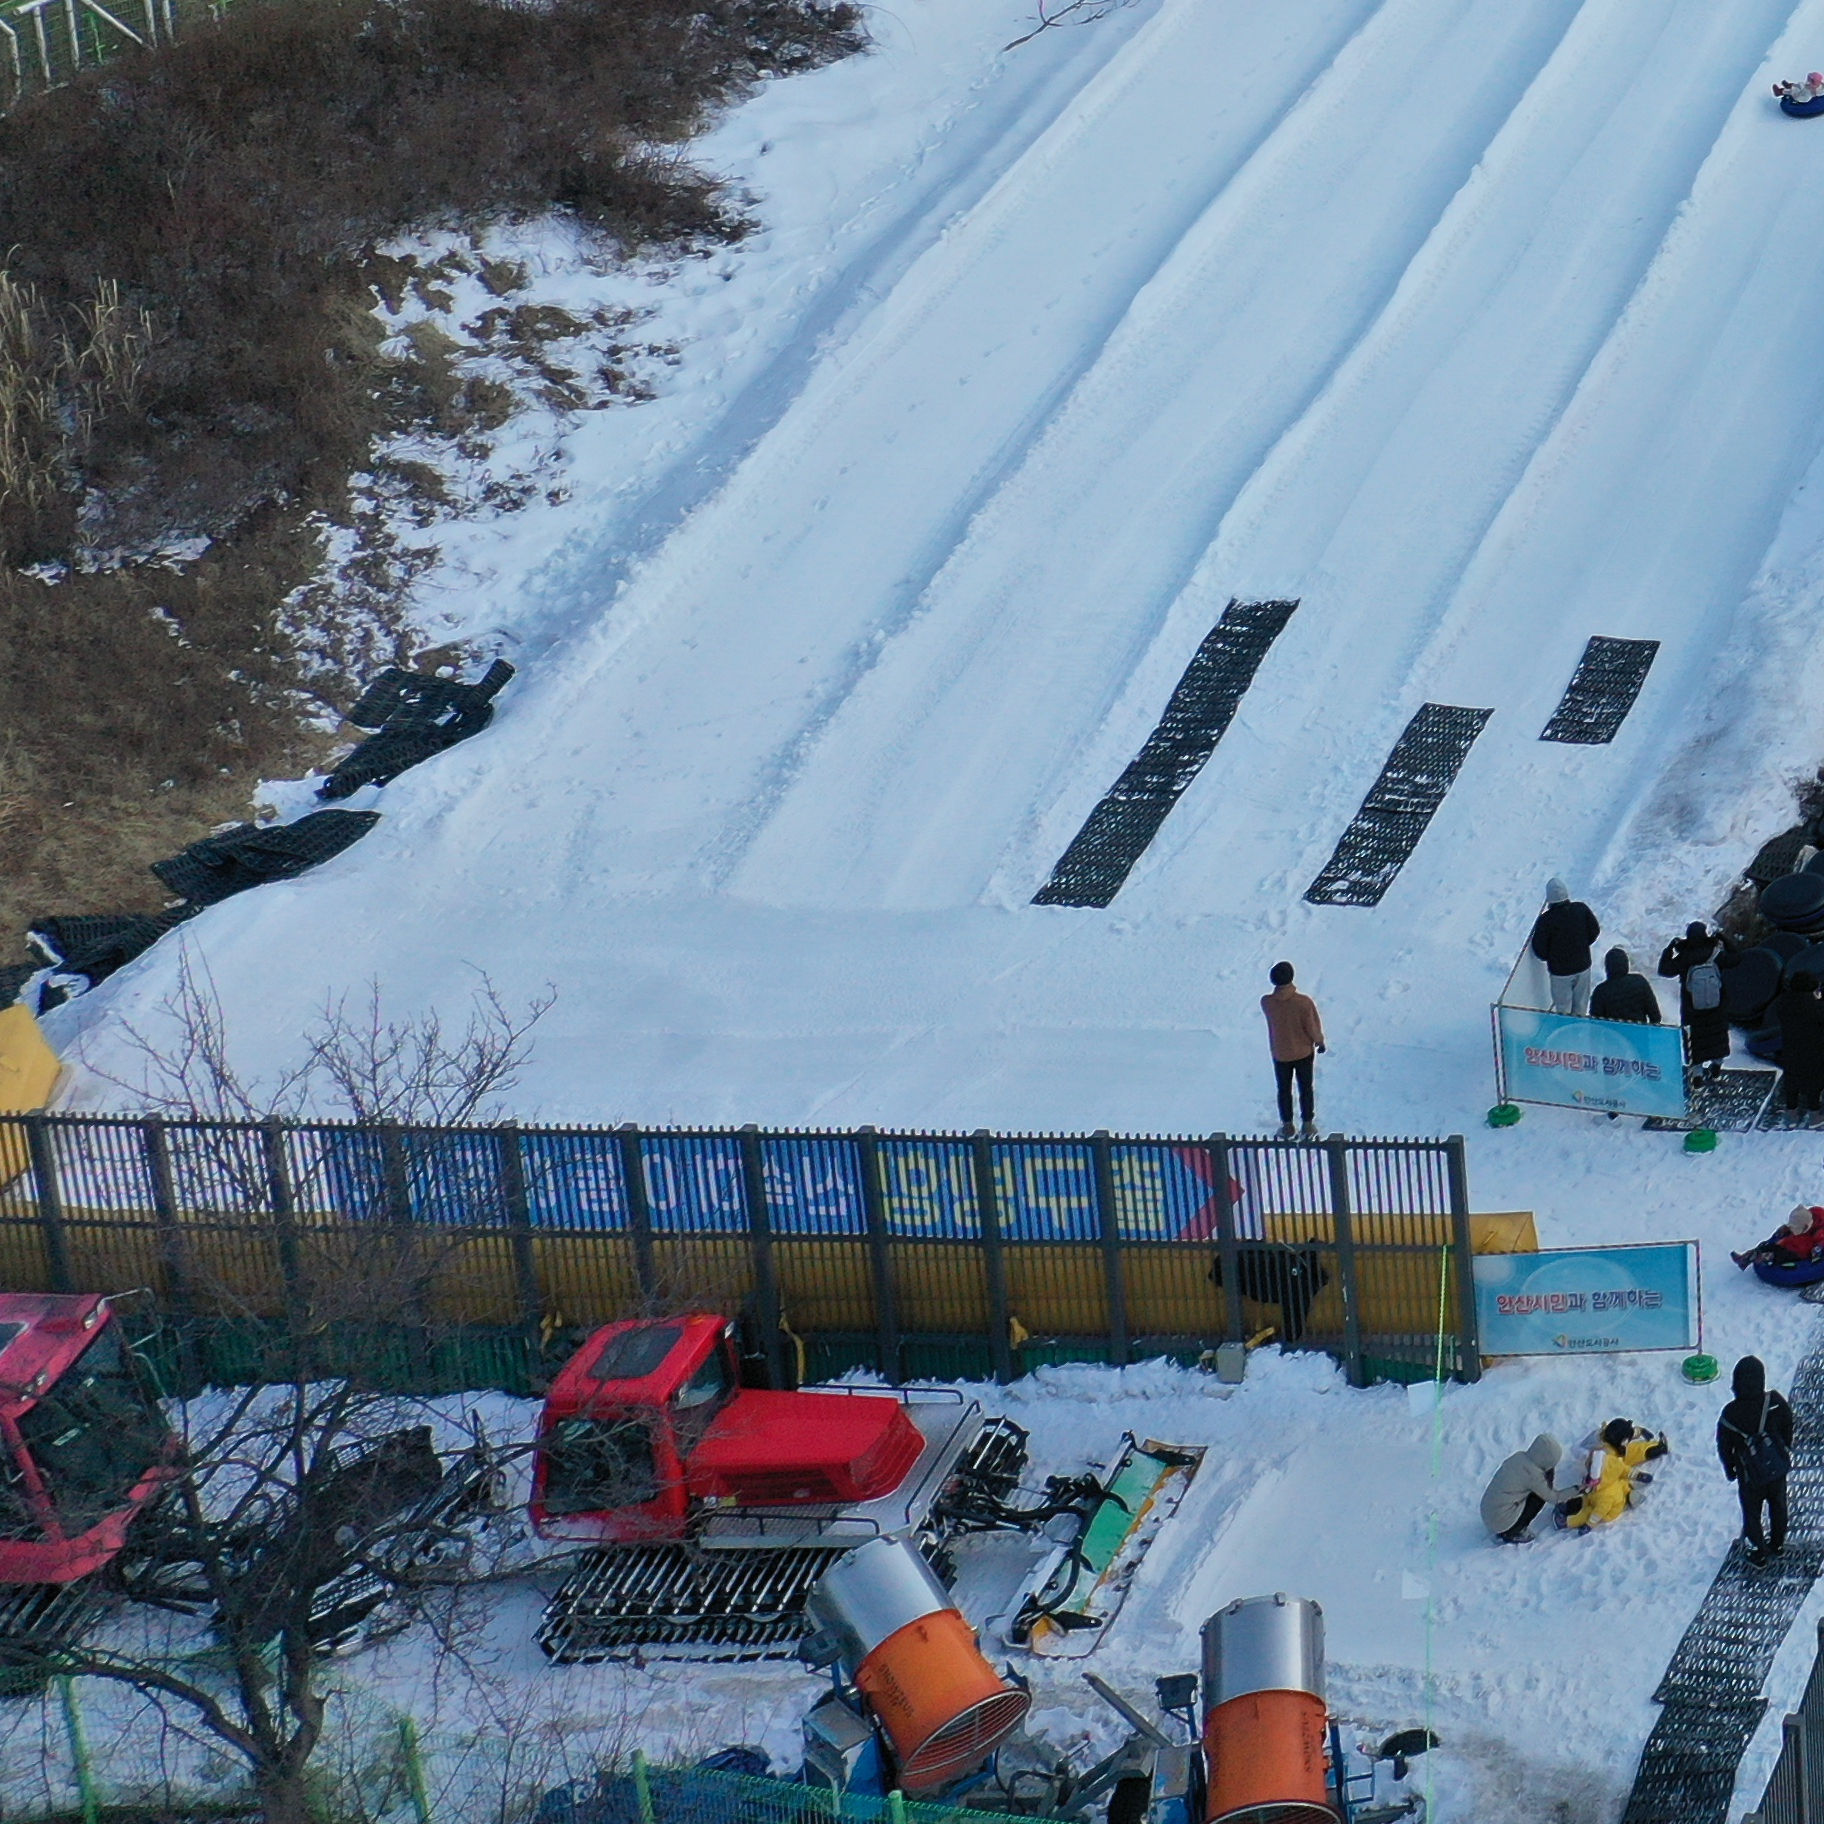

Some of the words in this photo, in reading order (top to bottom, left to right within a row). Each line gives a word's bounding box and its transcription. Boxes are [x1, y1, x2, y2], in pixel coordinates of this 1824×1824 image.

[1524, 1046, 1599, 1075] 안산시민과
[1602, 1054, 1662, 1082] 함께하는
[1496, 1290, 1586, 1316] 안산시민과
[1591, 1287, 1664, 1312] 함께하는
